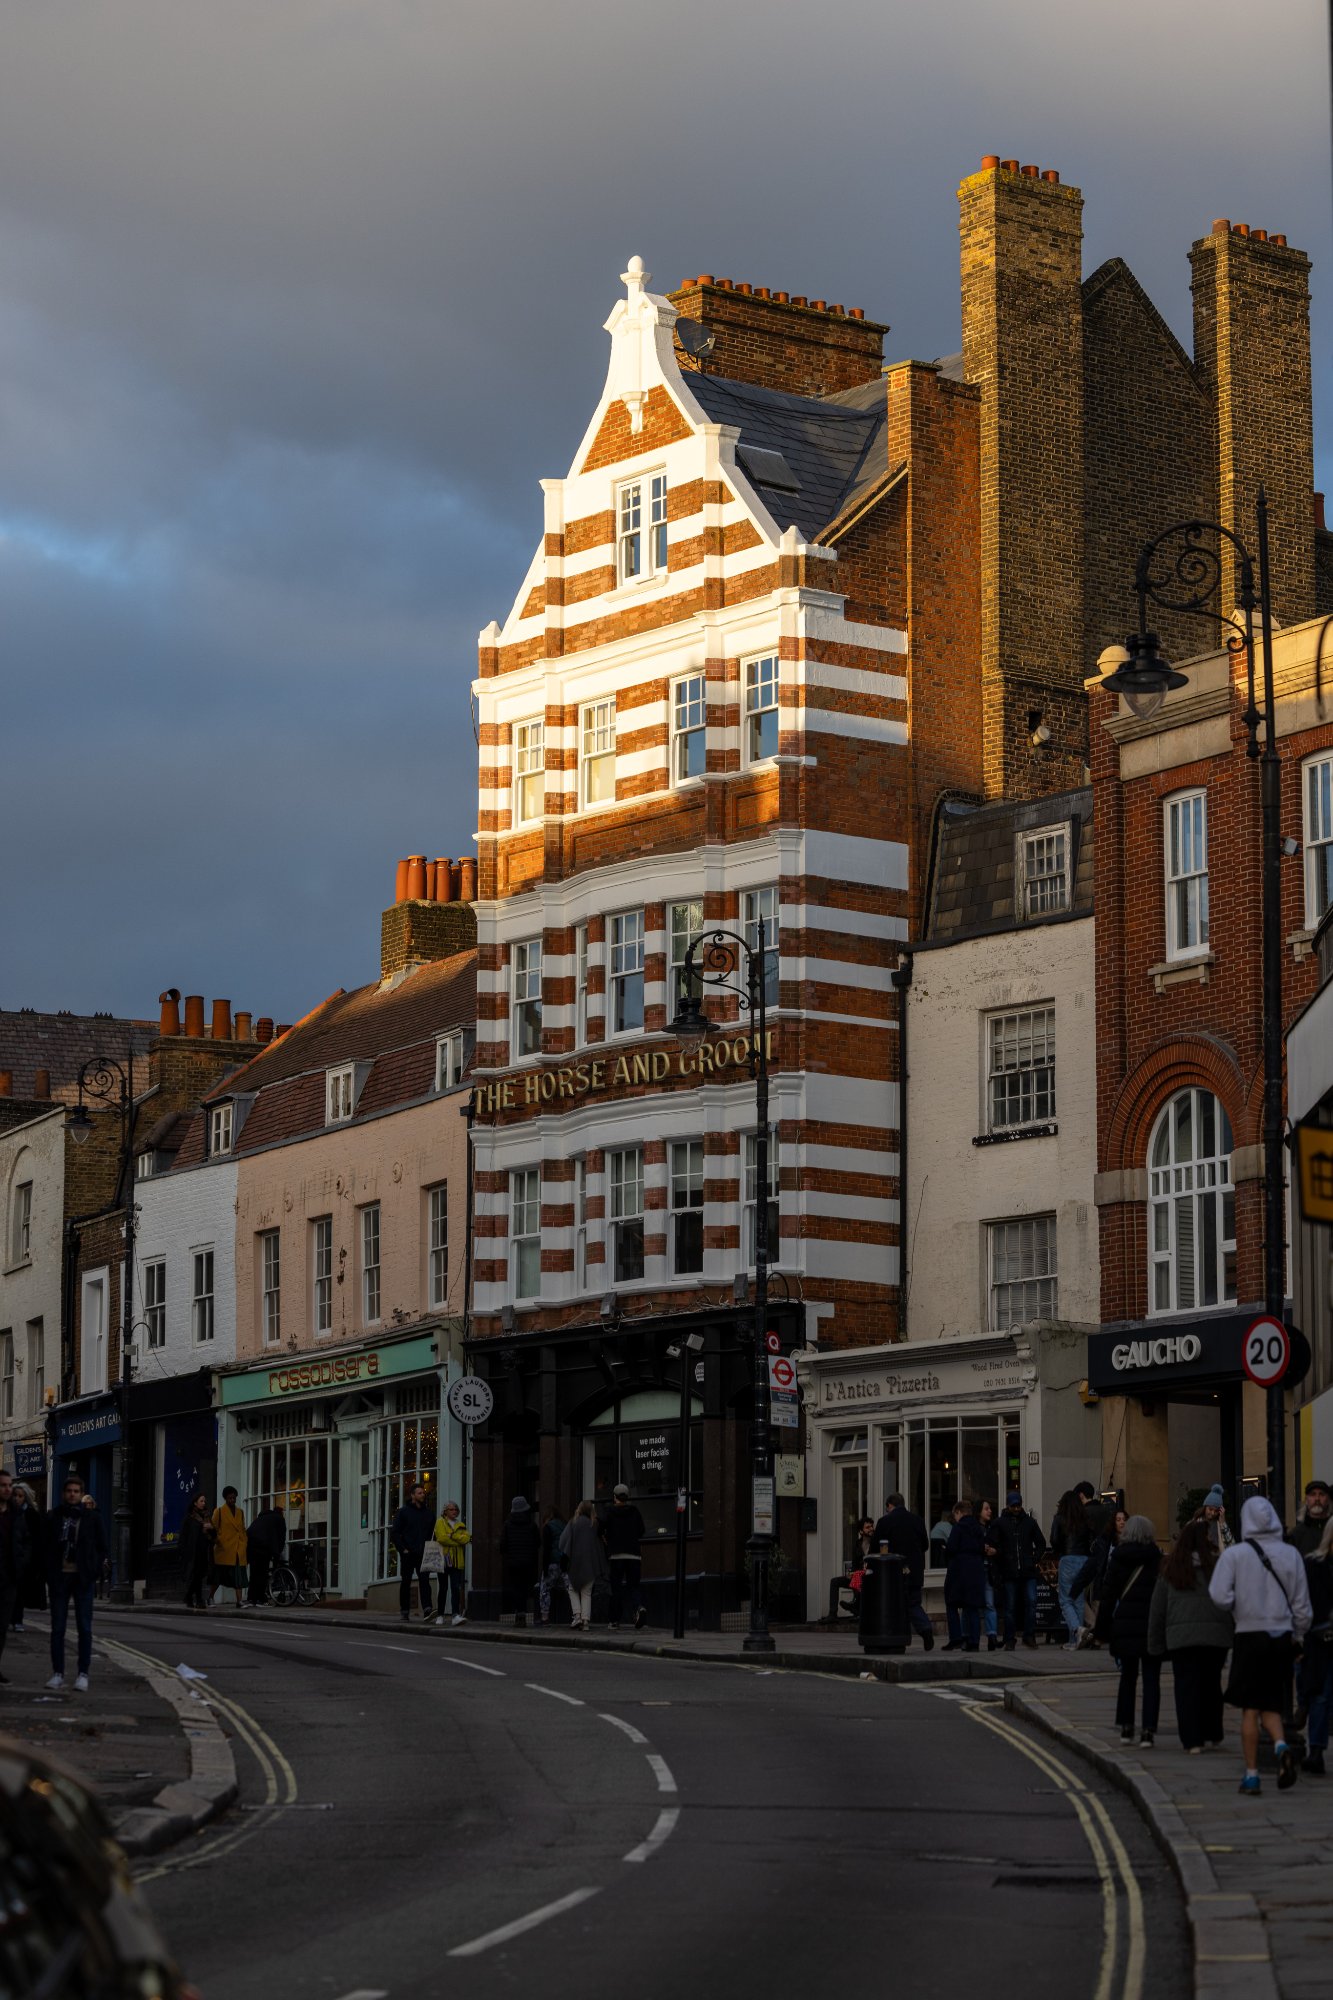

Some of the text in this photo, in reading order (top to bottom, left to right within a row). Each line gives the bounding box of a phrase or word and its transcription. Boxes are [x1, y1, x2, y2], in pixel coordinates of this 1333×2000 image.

[474, 1079, 517, 1114] THE
[525, 1059, 606, 1104] HORSE
[613, 1051, 671, 1085] AND
[1111, 1334, 1202, 1371] GAUCHO
[1250, 1336, 1282, 1366] 20
[971, 1362, 987, 1372] Wood
[1005, 1359, 1020, 1369] Oven
[454, 1379, 490, 1402] SKIN LAUNDRY
[825, 1371, 940, 1402] L'Antica Pizzeria
[463, 1394, 480, 1407] SL
[454, 1404, 490, 1421] CALIFORNIA
[68, 1418, 95, 1436] GILDEN'S
[95, 1415, 107, 1430] ART
[639, 1434, 666, 1446] we made
[16, 1446, 42, 1455] GILDEN'S
[635, 1447, 670, 1459] laser facials
[29, 1455, 41, 1463] ART
[18, 1465, 43, 1474] GALLERY
